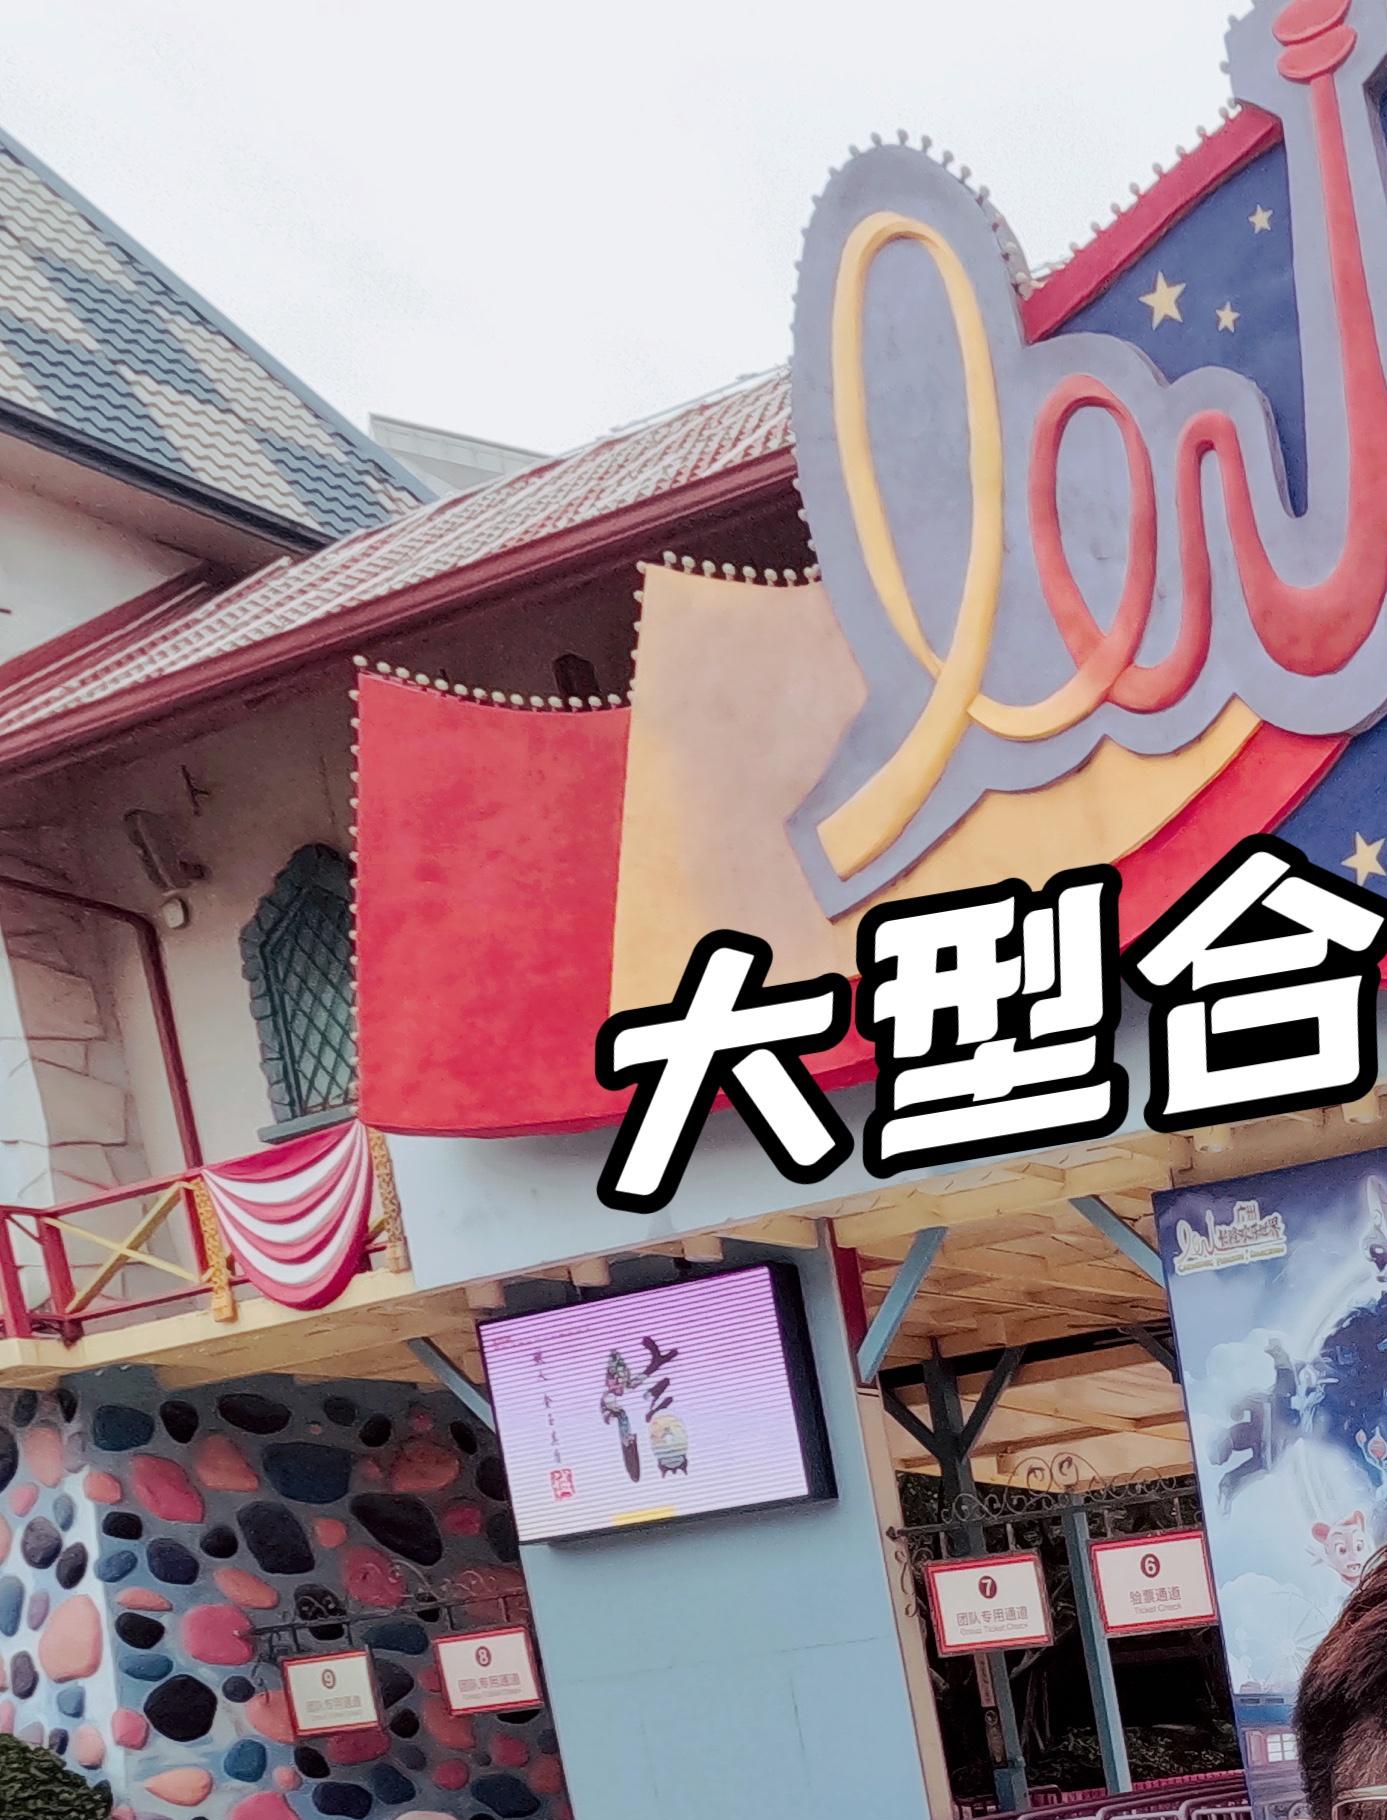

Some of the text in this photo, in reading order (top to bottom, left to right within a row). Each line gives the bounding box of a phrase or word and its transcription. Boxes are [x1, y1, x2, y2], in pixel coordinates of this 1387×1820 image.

[1143, 1555, 1158, 1576] 6
[956, 1606, 1029, 1626] 团队专用通道
